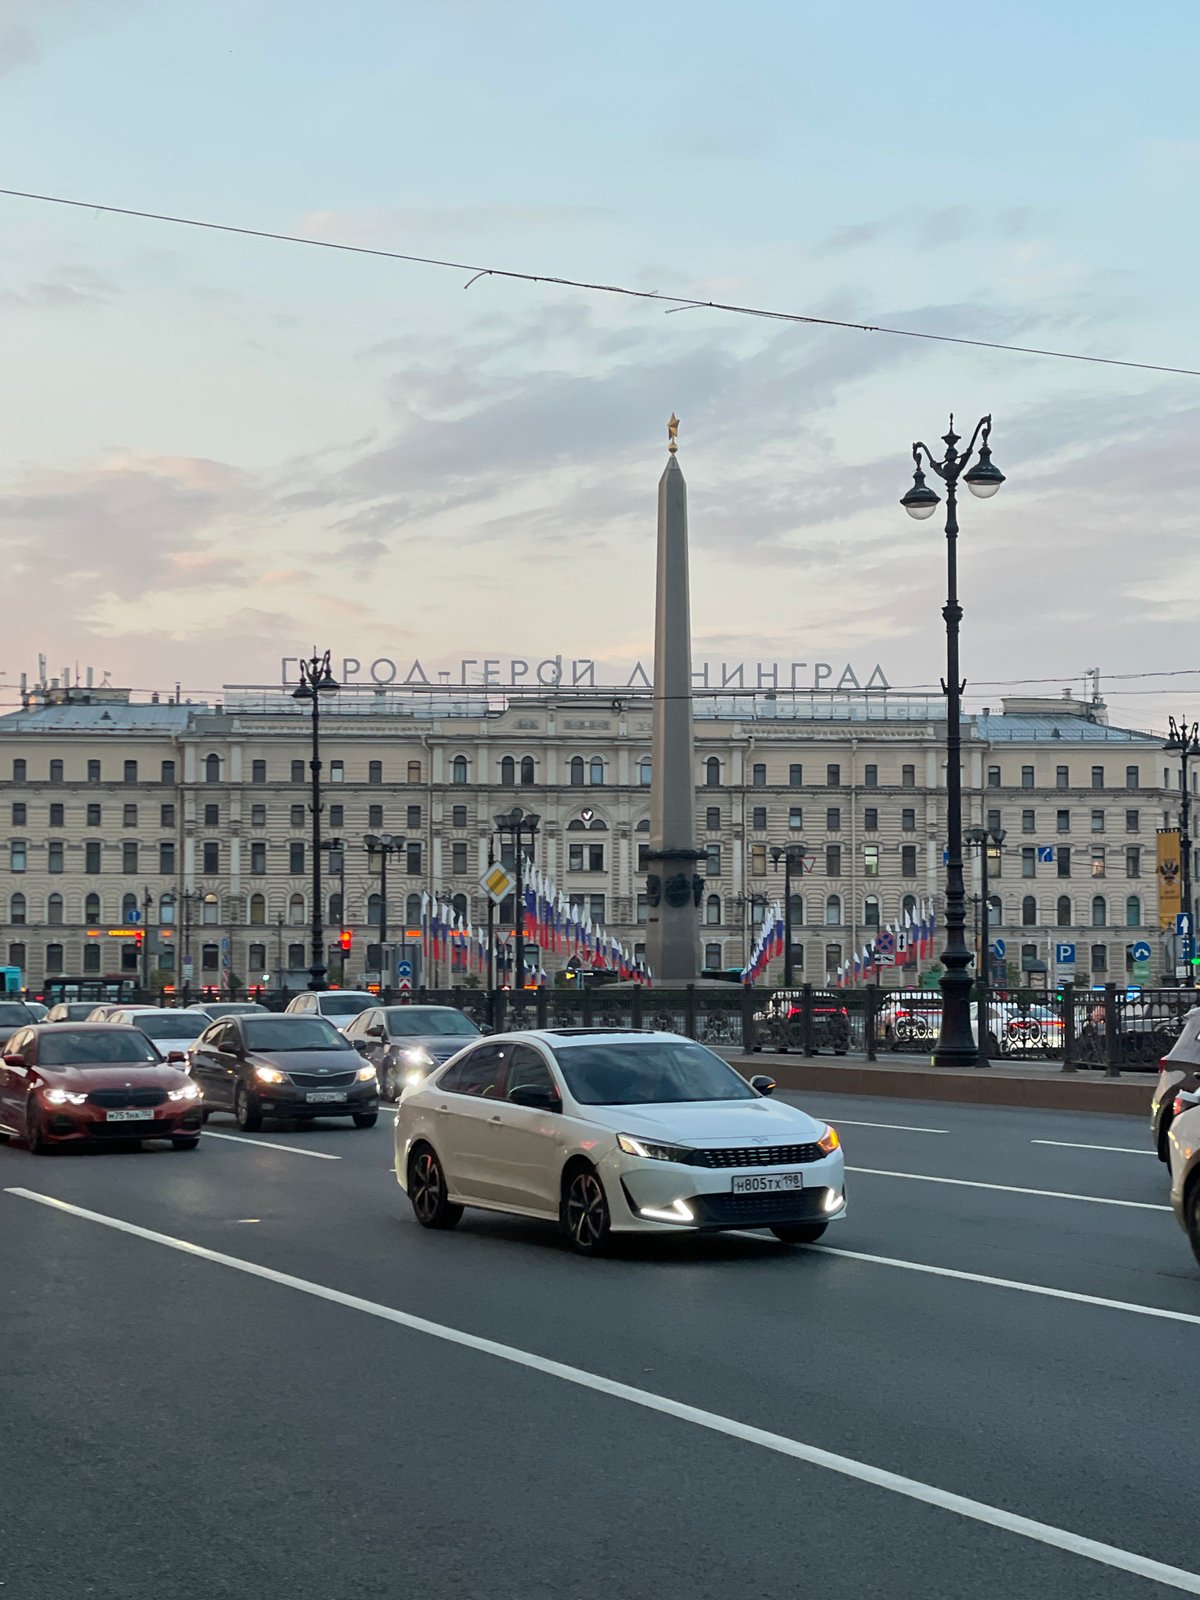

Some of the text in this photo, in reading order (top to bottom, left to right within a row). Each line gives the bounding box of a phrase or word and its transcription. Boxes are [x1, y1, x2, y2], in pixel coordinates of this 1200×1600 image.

[282, 658, 892, 689] ГРОД-ГЕРОЙ ЛНИНГРАД
[1060, 945, 1072, 962] P
[736, 1177, 781, 1192] Н805ТХ
